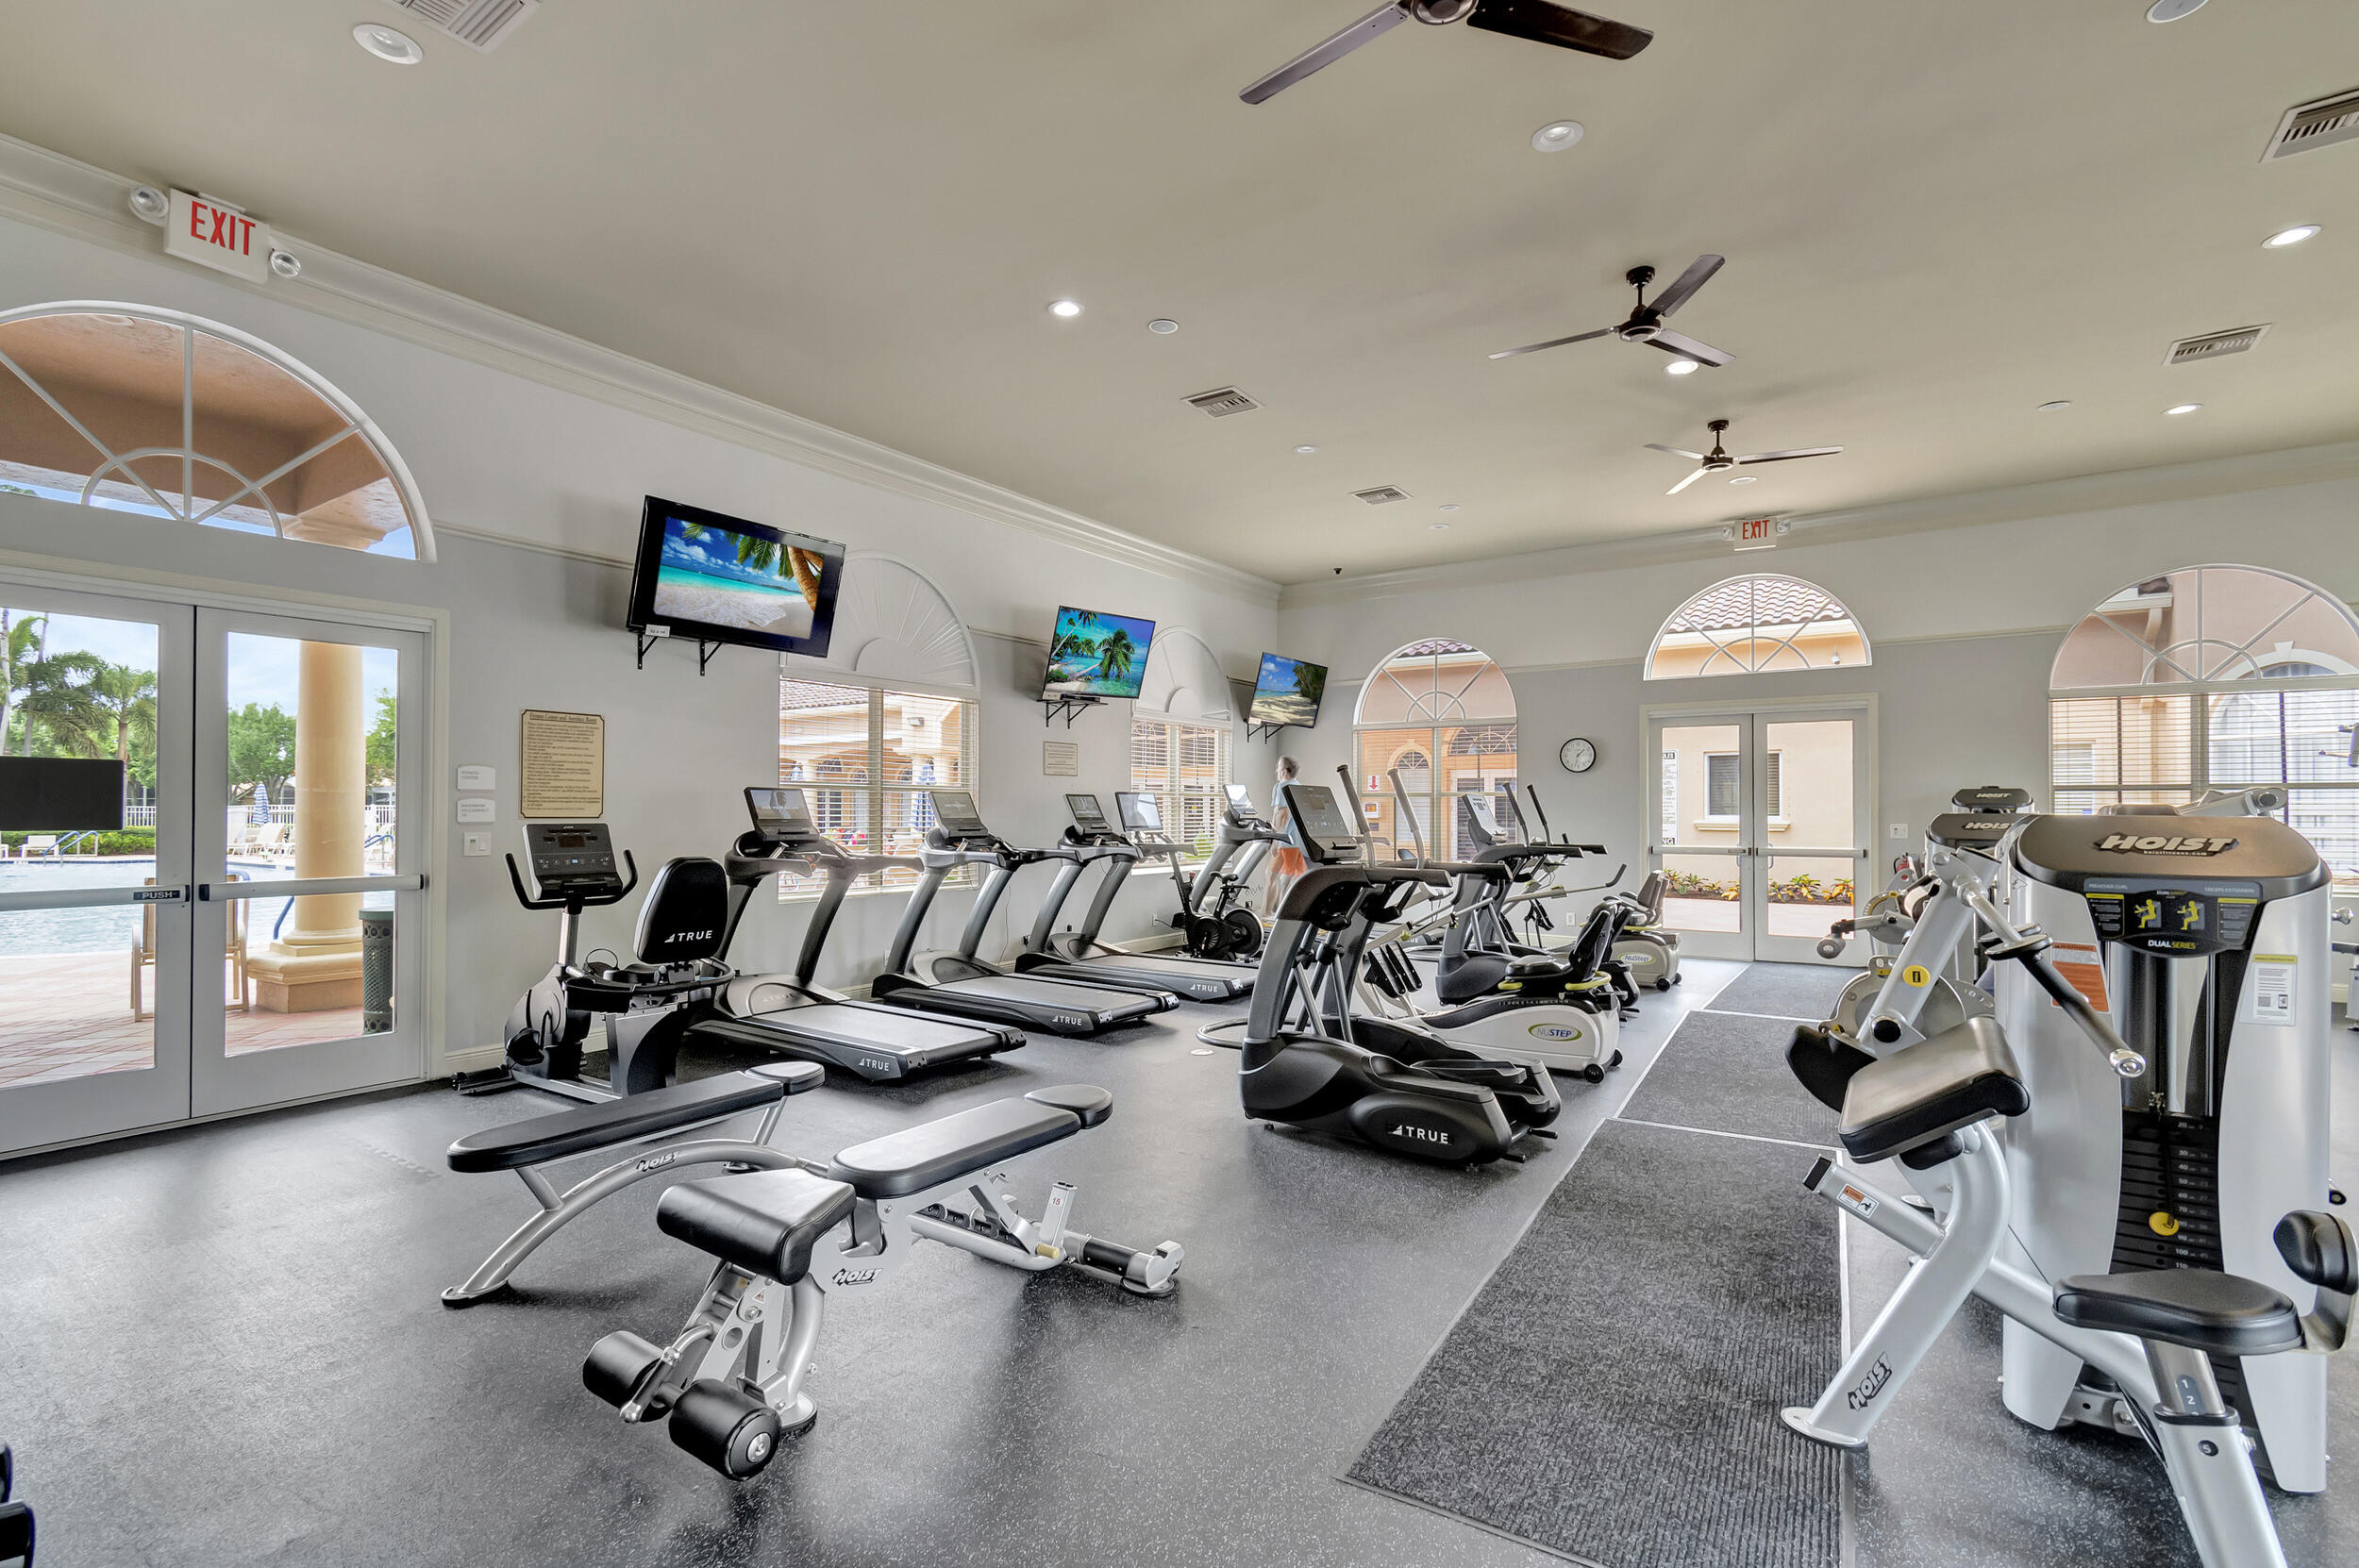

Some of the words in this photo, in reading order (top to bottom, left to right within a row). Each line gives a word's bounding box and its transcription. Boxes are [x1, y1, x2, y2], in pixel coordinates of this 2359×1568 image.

[191, 200, 257, 257] EXIT
[1742, 519, 1770, 540] EXIT
[2100, 835, 2233, 852] HOIST
[143, 891, 173, 900] PUSH
[678, 930, 713, 942] TRUE
[1196, 984, 1218, 993] TRUE
[1060, 1015, 1082, 1026] TRUE
[1536, 1027, 1573, 1038] NUSTEP
[866, 1059, 890, 1072] TRUE
[1406, 1125, 1449, 1144] TRUE
[638, 1151, 680, 1172] HOIST
[1052, 1197, 1061, 1206] 15
[835, 1267, 883, 1285] HOIST
[1849, 1351, 1893, 1411] HOIST
[2181, 1378, 2188, 1389] 1
[2186, 1395, 2196, 1405] 2
[2202, 1443, 2212, 1454] 5
